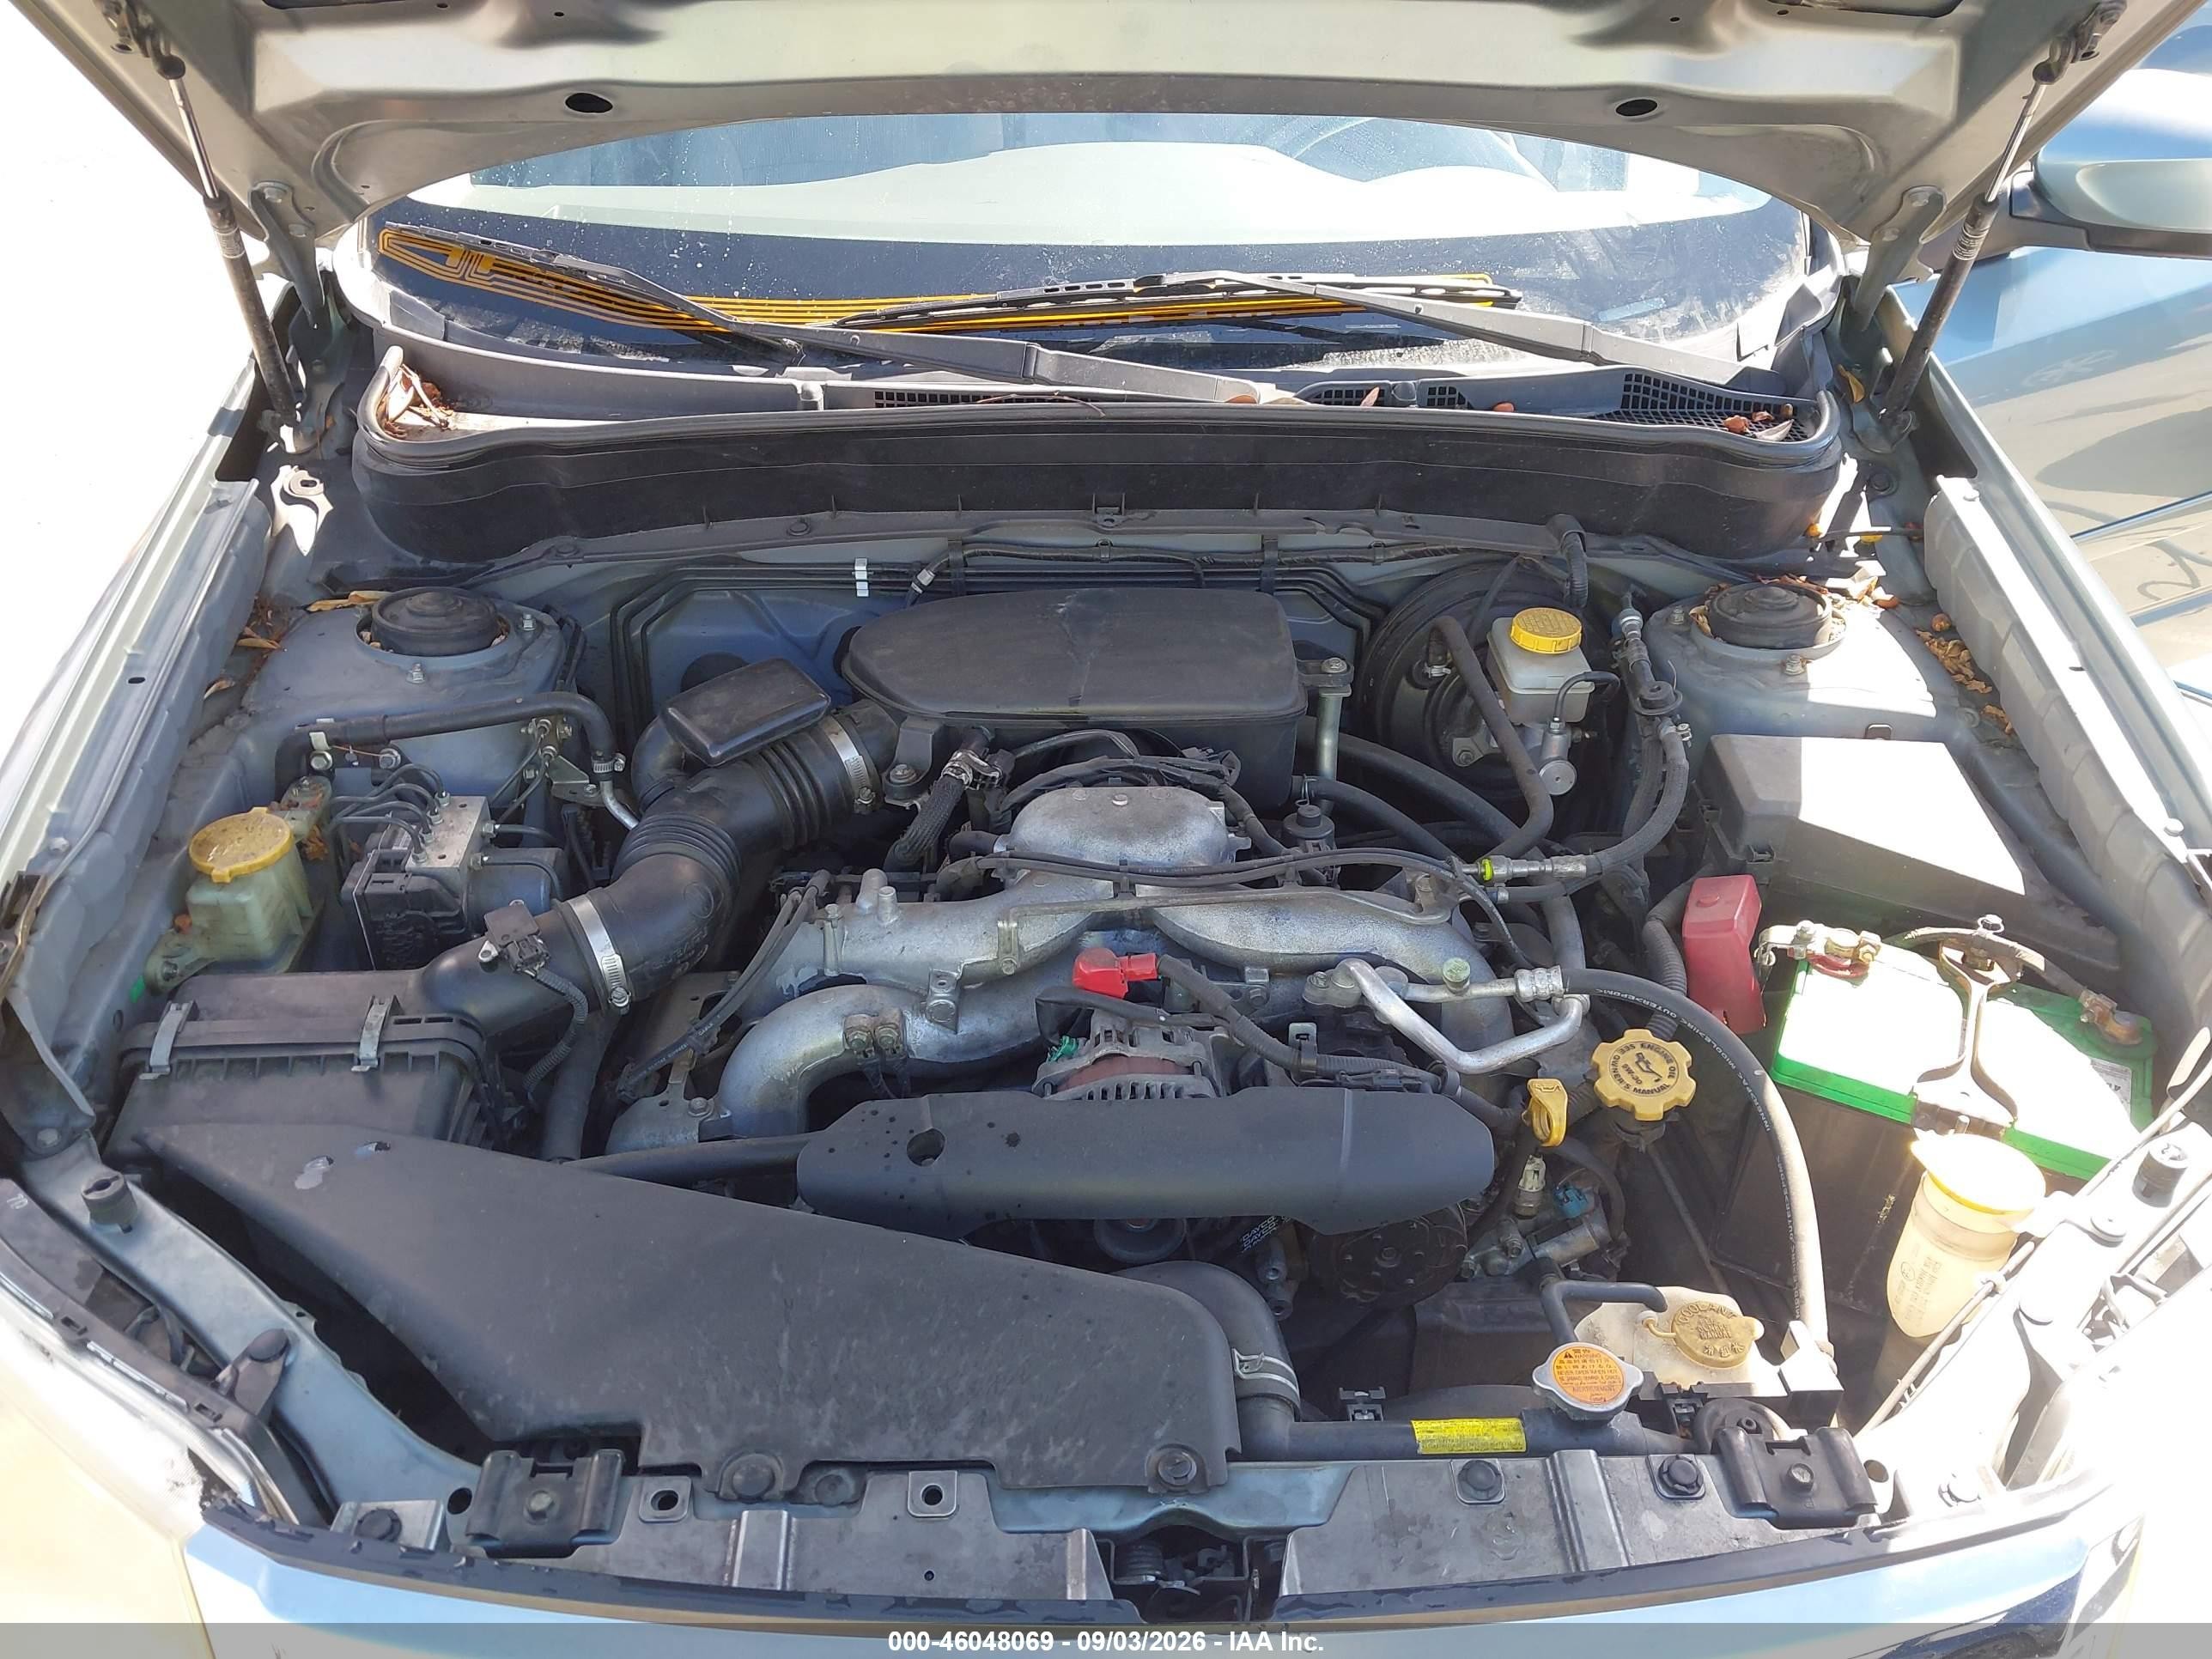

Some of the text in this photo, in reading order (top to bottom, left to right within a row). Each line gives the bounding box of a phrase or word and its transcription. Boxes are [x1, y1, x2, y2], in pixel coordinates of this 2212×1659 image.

[1619, 1042, 1677, 1079] SEE ENGINE OIL
[1621, 1062, 1643, 1085] 5W-30
[1632, 1082, 1671, 1096] MANUAL
[1242, 1215, 1277, 1242] DAYCO
[1677, 1303, 1738, 1326] COOLANT
